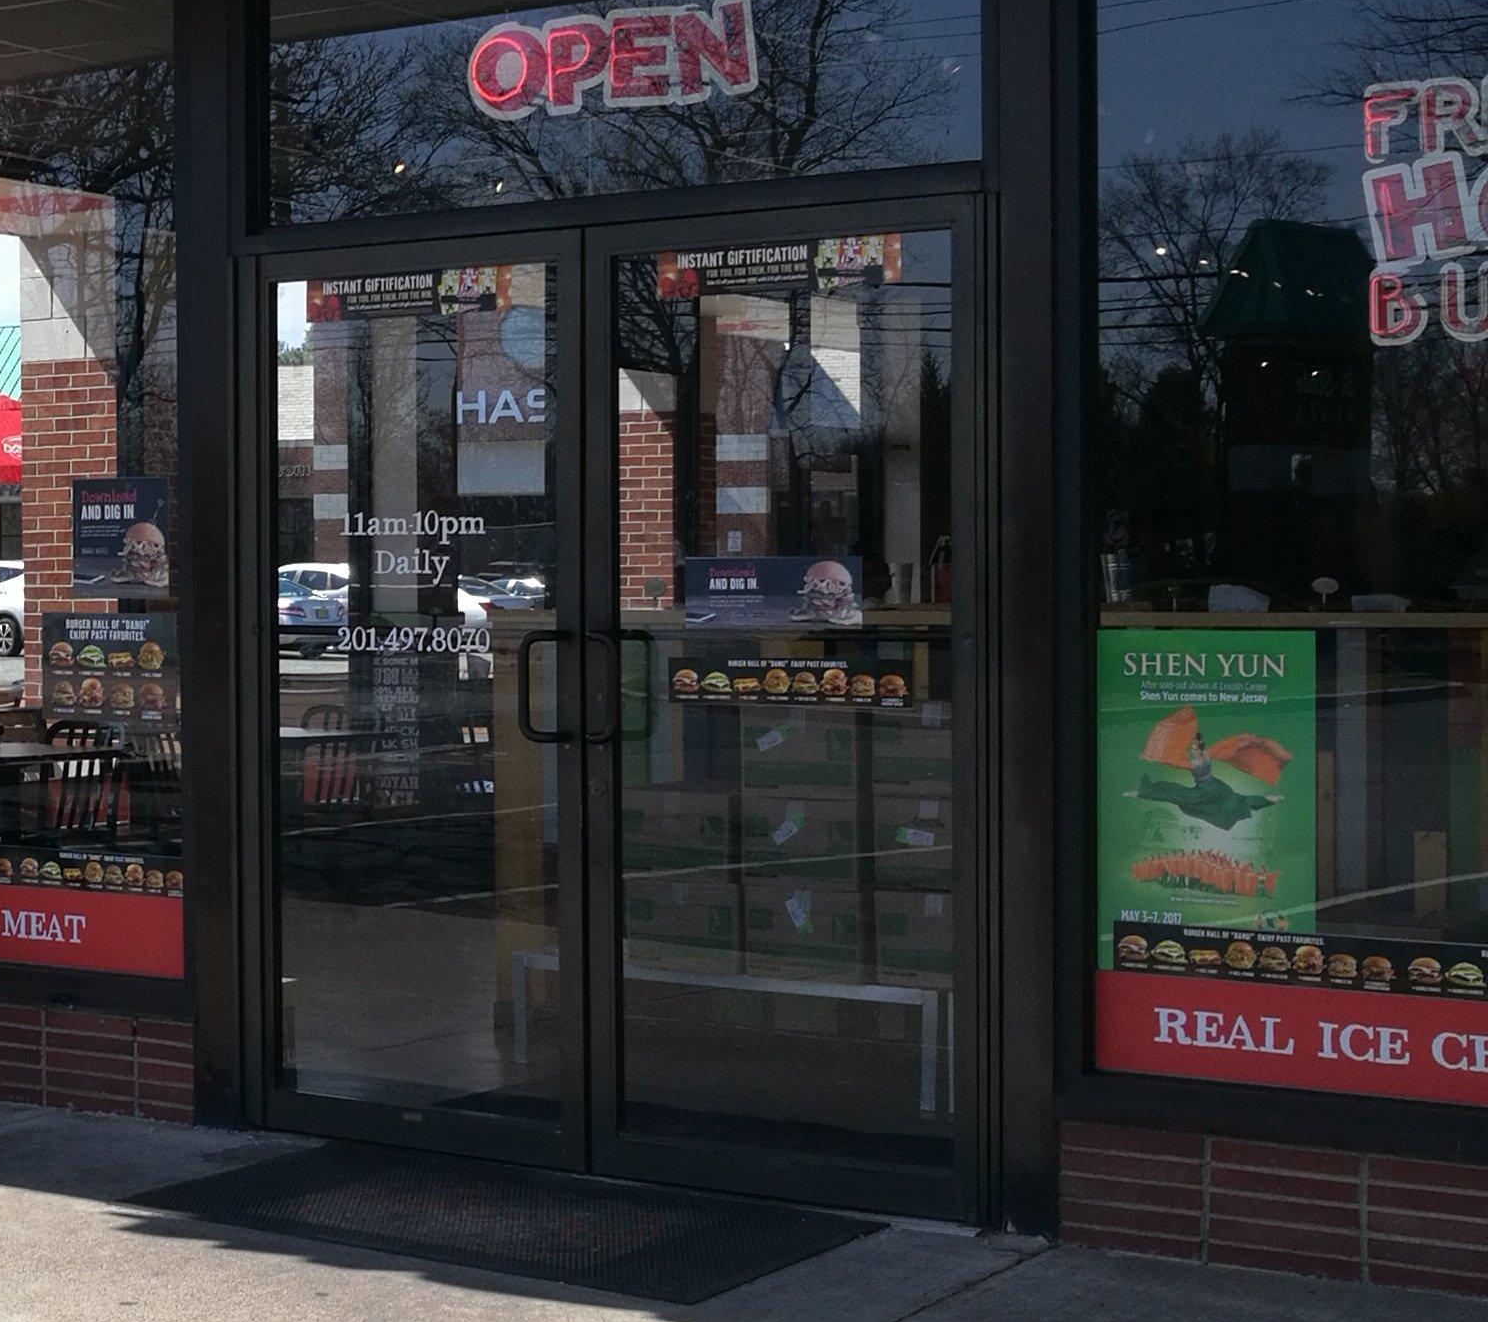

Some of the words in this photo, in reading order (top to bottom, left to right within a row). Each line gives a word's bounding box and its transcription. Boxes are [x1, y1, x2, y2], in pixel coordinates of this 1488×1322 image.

[677, 251, 724, 269] INSTANT
[727, 244, 808, 265] GIFTIFICATION
[323, 279, 363, 295] INSTANT
[365, 274, 433, 293] GIFTIFICATION
[81, 505, 101, 520] AND
[104, 504, 121, 520] DIG
[340, 510, 486, 545] 11am-10pm
[374, 548, 450, 586] Daily
[709, 578, 727, 590] AND
[730, 578, 745, 590] DIG
[65, 619, 91, 629] BURGER
[92, 619, 109, 629] HALL
[337, 626, 491, 653] 201.497.8070
[1123, 651, 1207, 677] SHEN
[1216, 653, 1286, 678] YUN
[1140, 691, 1160, 701] Shen
[1162, 691, 1179, 701] Yun
[1180, 692, 1207, 701] comes
[1209, 692, 1216, 701] to
[1219, 692, 1239, 702] New
[1240, 693, 1268, 703] Jersey
[1, 908, 87, 945] MEAT
[1121, 909, 1140, 923] MAY
[1162, 911, 1182, 925] 2017
[1153, 1006, 1295, 1056] REAL
[1317, 1021, 1411, 1066] ICE
